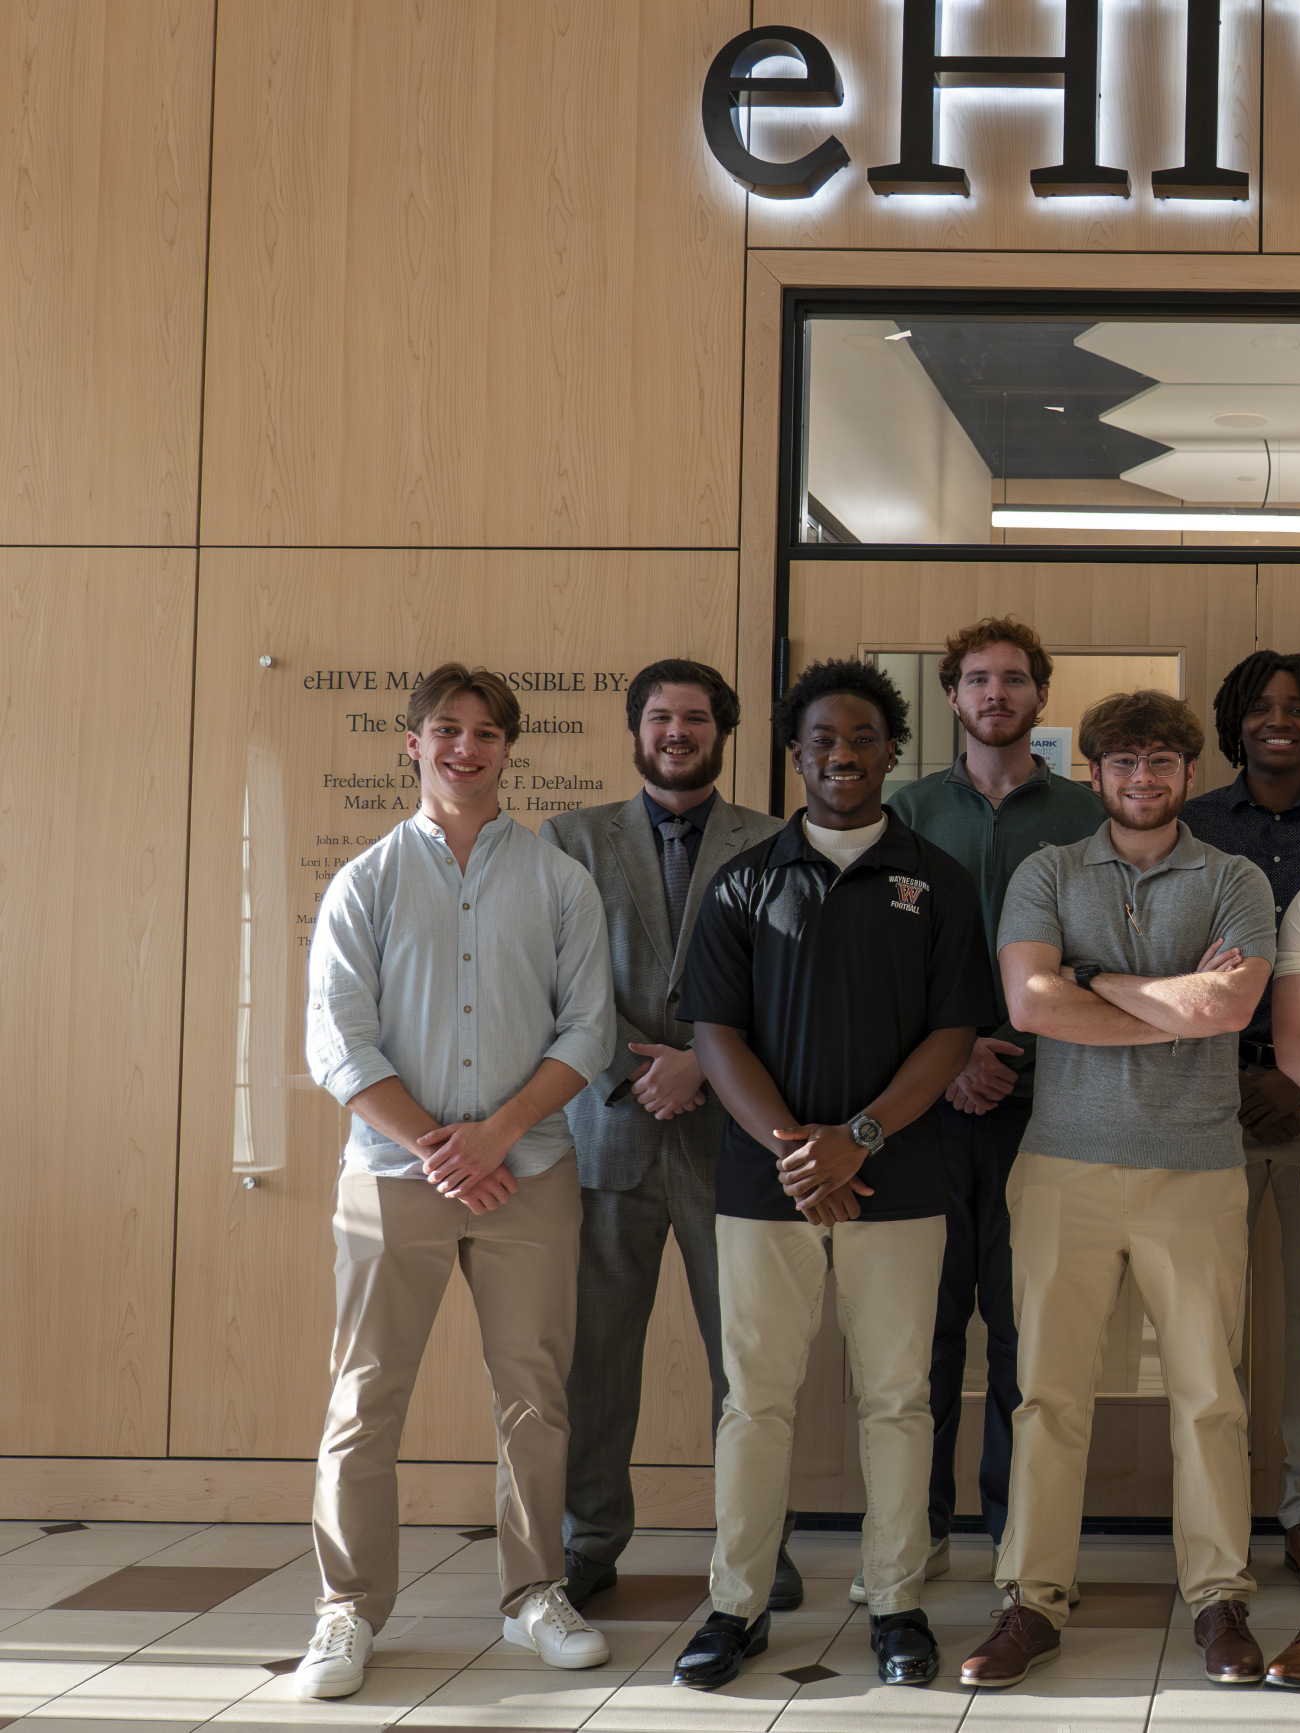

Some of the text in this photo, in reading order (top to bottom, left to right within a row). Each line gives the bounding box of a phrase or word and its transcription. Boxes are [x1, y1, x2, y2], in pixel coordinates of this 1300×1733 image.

[303, 671, 378, 690] eHIVE
[385, 671, 425, 690] MA
[593, 672, 629, 692] BY:
[346, 713, 387, 732] The
[519, 714, 584, 733] dation
[1030, 740, 1058, 748] HARK
[323, 773, 395, 788] Frederick
[400, 775, 418, 789] D.
[514, 776, 526, 789] F.
[531, 775, 604, 790] DePalma
[343, 795, 387, 810] Mark
[392, 796, 409, 810] A.
[506, 797, 520, 811] L.
[526, 797, 583, 811] Harner
[316, 835, 339, 846] John
[342, 836, 353, 845] R.
[301, 857, 321, 867] Lori
[889, 875, 930, 892] WAYNESBURG
[890, 899, 920, 915] FOOTBALL
